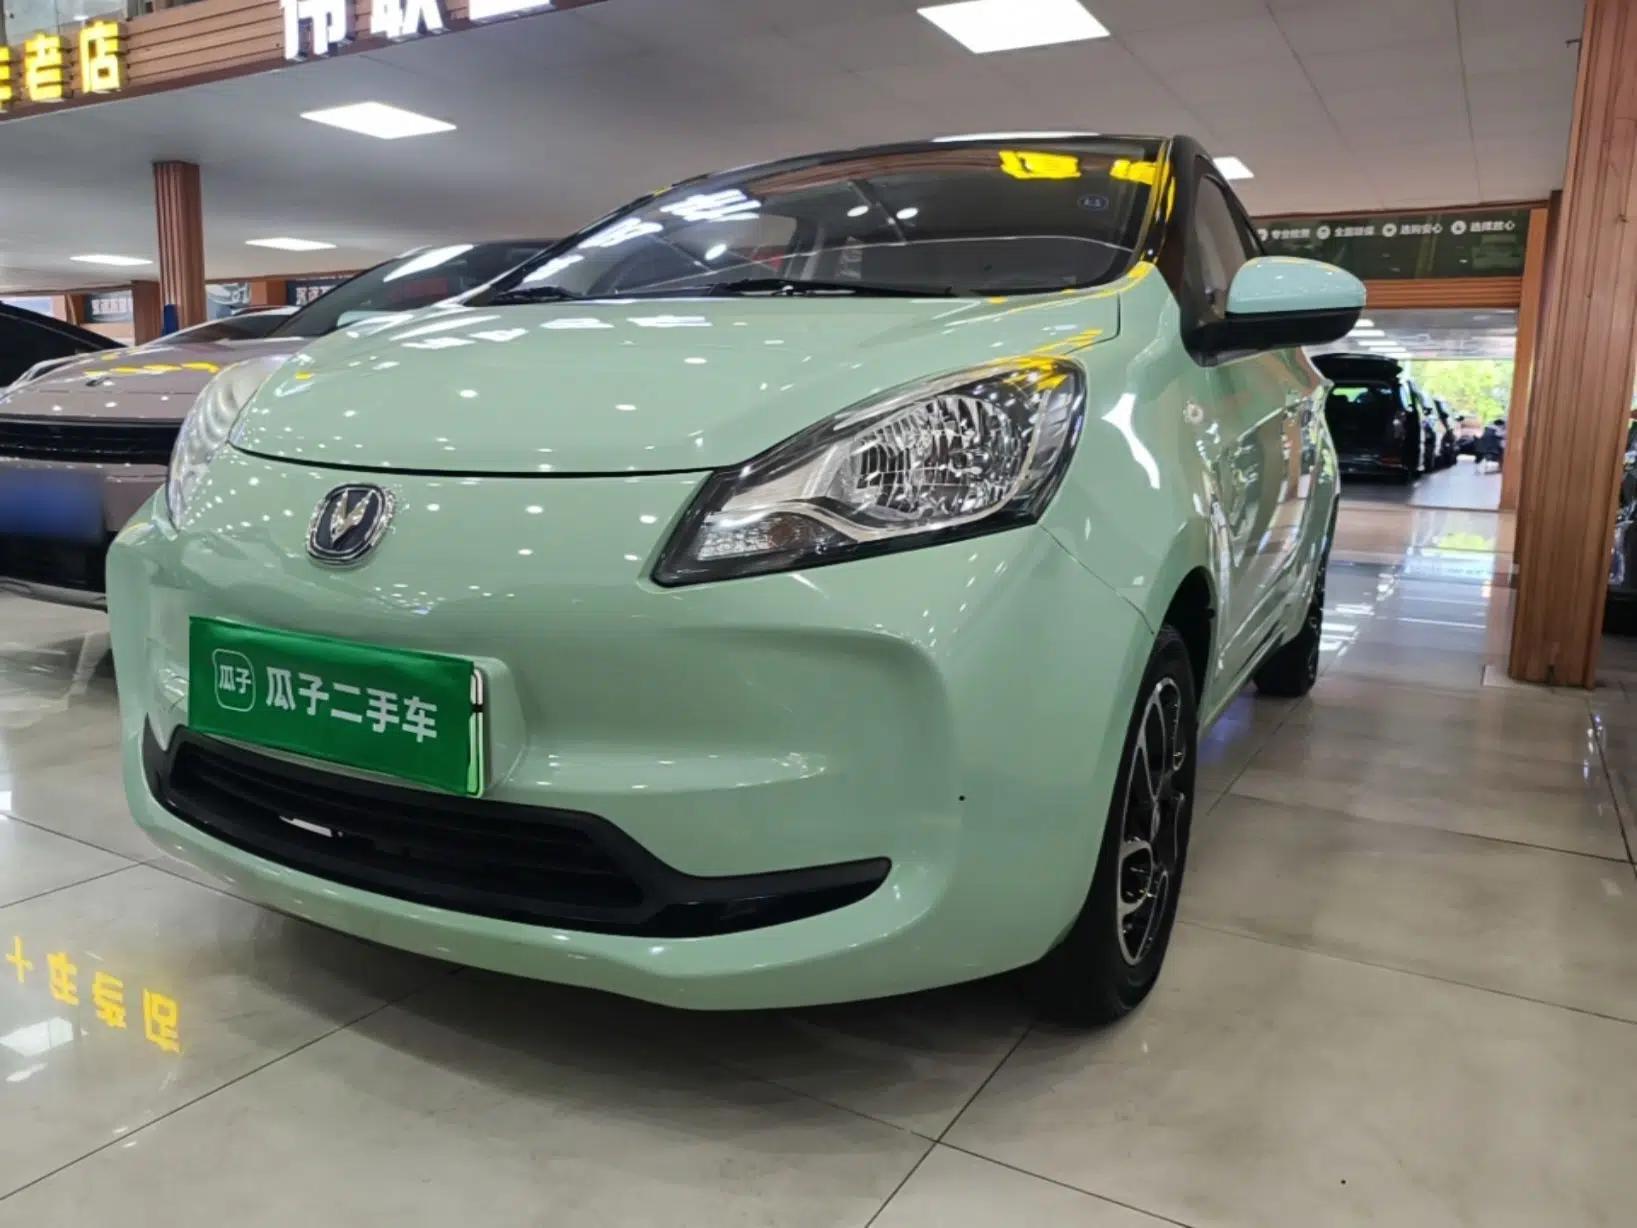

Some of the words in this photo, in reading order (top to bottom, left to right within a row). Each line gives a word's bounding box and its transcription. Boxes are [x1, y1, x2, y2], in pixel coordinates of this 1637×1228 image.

[0, 20, 121, 102] 老店
[218, 664, 252, 694] 瓜子
[265, 666, 438, 743] 瓜子二手车
